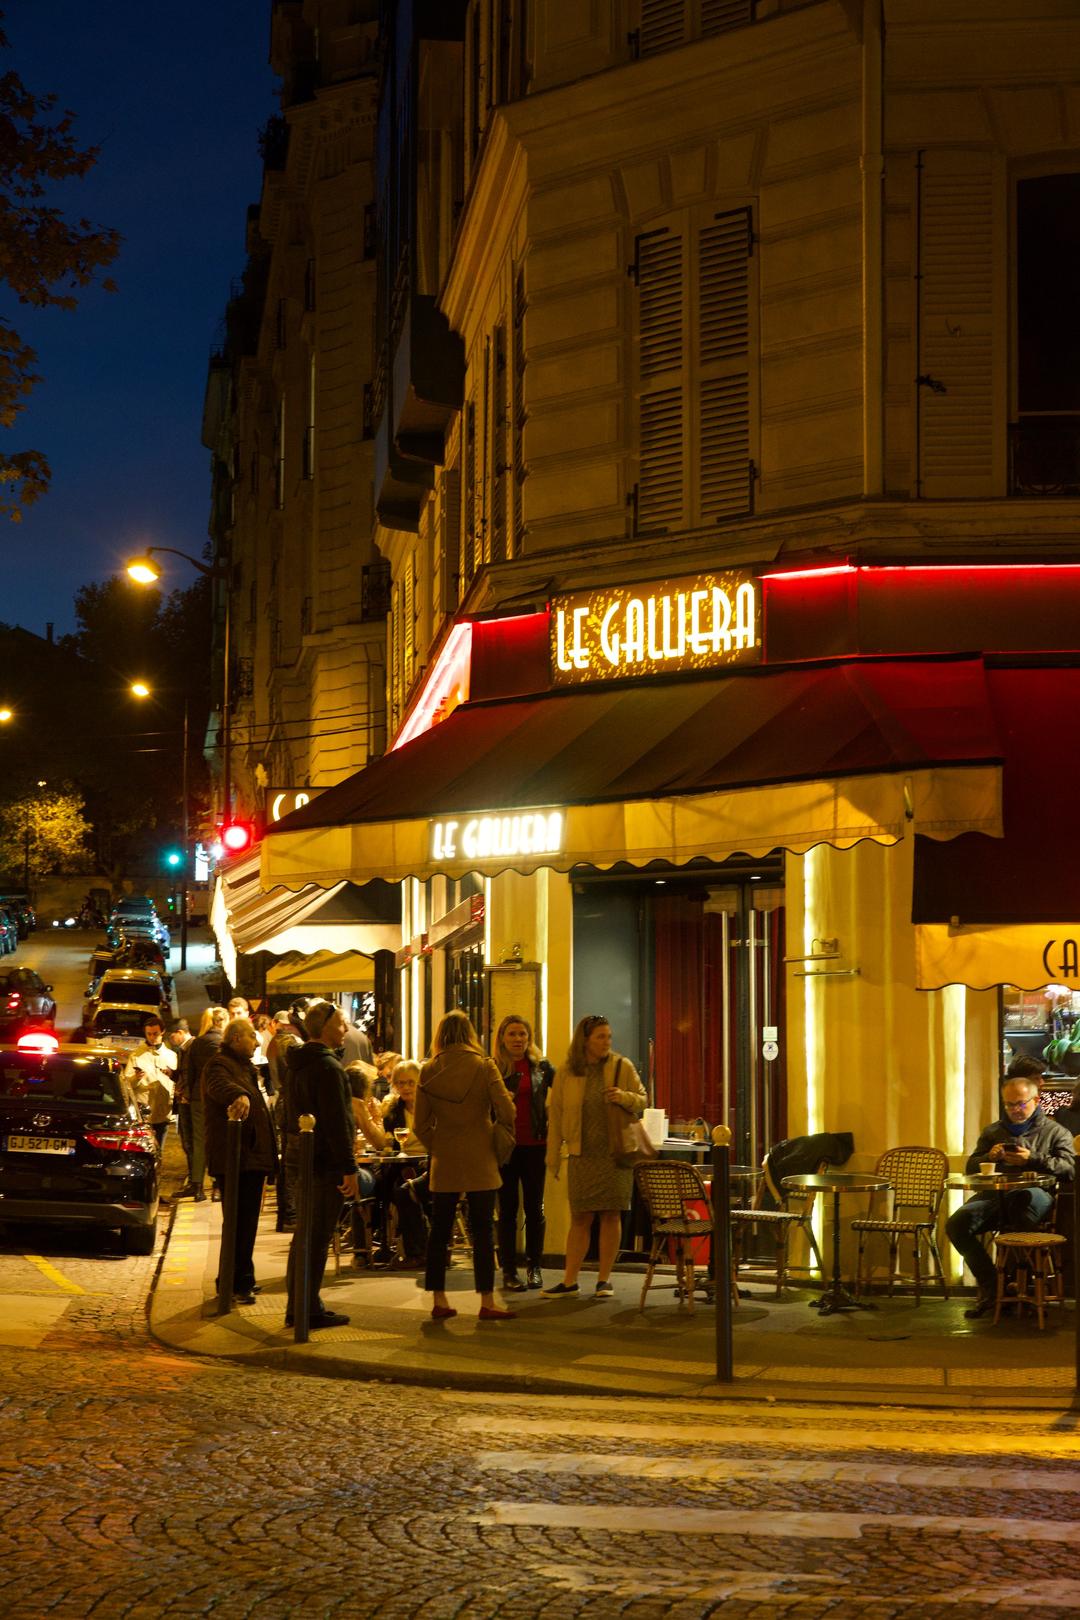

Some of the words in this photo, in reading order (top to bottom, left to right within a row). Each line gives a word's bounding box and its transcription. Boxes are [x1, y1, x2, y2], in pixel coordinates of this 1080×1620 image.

[557, 607, 590, 671] LE
[600, 582, 755, 667] GALLIERA
[433, 820, 459, 860] LE
